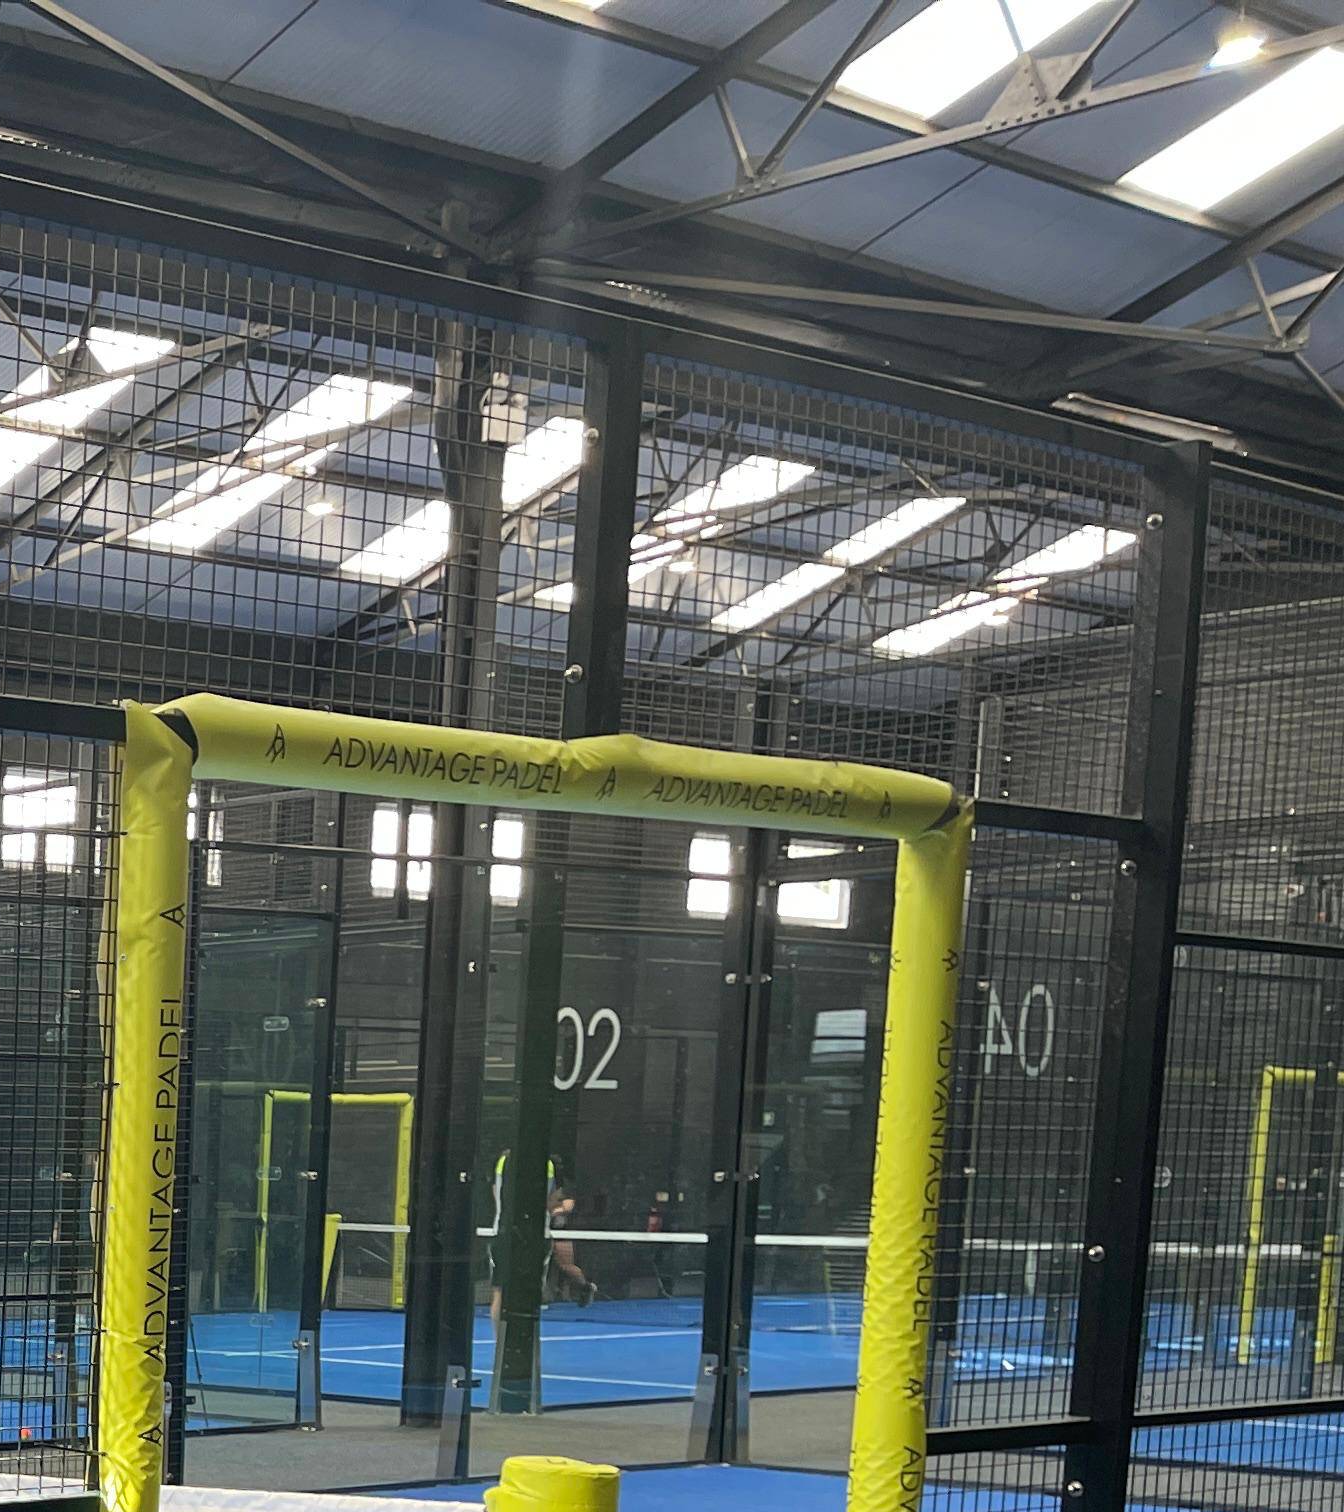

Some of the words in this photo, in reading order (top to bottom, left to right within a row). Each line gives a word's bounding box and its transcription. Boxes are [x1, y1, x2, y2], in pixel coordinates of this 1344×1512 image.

[322, 736, 486, 785] ADVANTAGE
[487, 757, 562, 794] PADEL
[644, 776, 786, 813] ADVANTAGE
[785, 787, 849, 818] PADEL
[143, 1123, 177, 1362] ADVANTAGE
